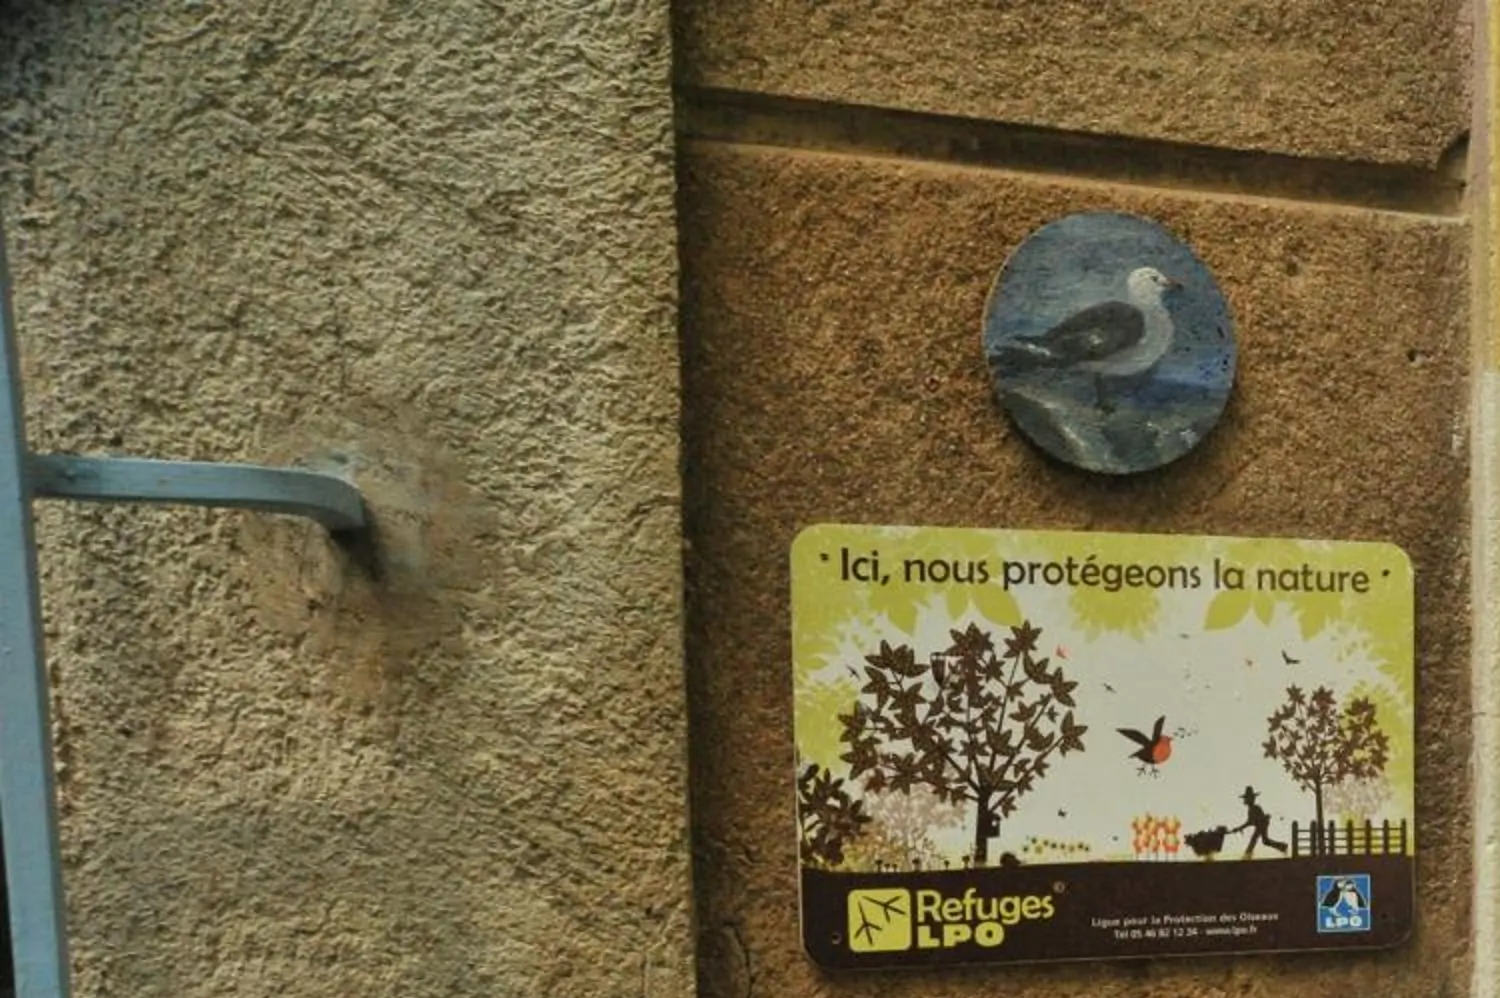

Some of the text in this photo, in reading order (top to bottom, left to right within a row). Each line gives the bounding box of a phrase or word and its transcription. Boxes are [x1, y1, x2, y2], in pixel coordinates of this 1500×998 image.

[841, 548, 1369, 593] Ici, nous protégeons la nature
[916, 887, 1055, 925] Refuges
[1091, 917, 1120, 928] Ligue
[1163, 913, 1217, 925] Protection
[1325, 915, 1362, 928] LPO
[917, 921, 1005, 948] LPO
